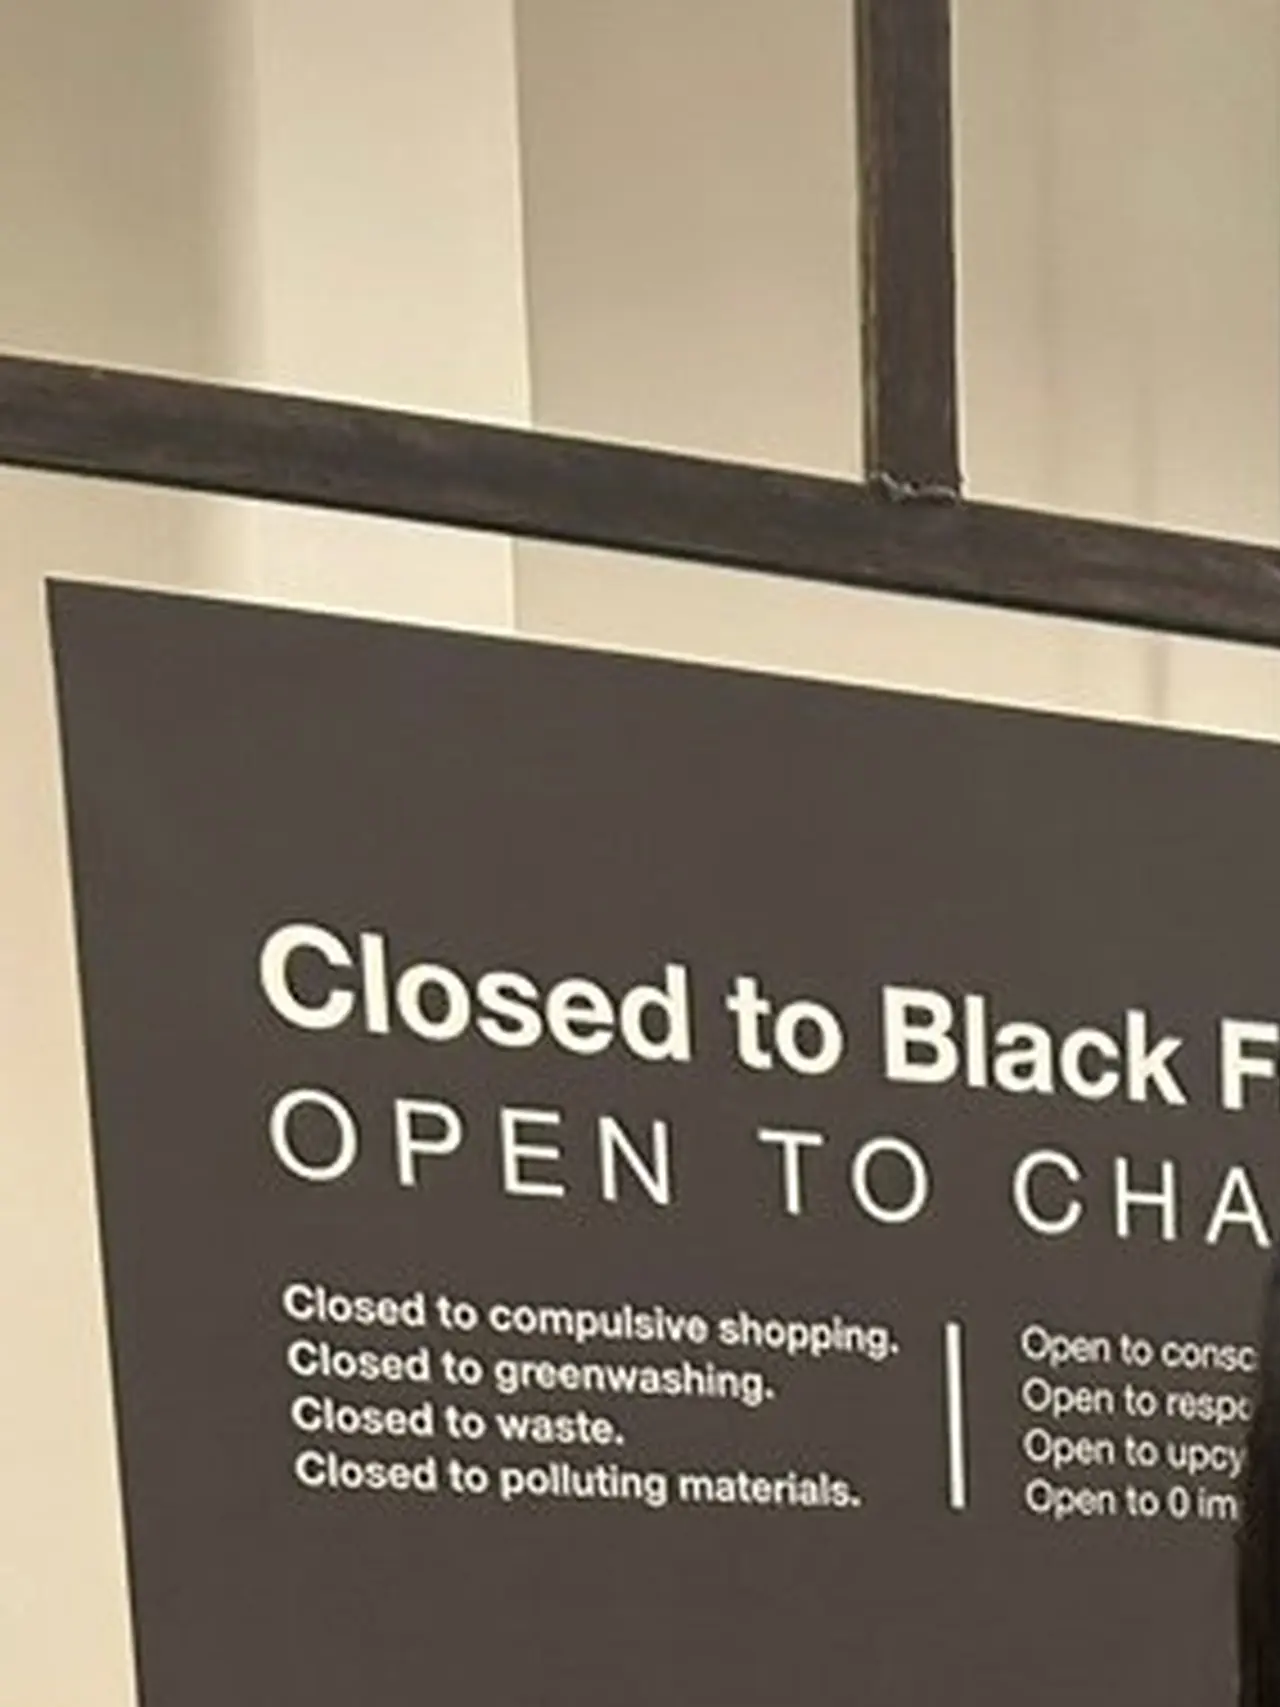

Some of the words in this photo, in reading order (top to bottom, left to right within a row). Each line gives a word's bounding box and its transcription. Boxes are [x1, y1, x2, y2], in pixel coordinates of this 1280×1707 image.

[260, 923, 691, 1062] Closed
[725, 976, 843, 1075] to
[883, 985, 1187, 1106] Black
[270, 1089, 670, 1205] OPEN
[758, 1128, 928, 1223] TO
[1013, 1149, 1271, 1248] CHA
[283, 1283, 426, 1327] Closed
[435, 1295, 478, 1331] to
[488, 1304, 709, 1344] compulsive
[718, 1311, 899, 1361] shopping.
[1021, 1325, 1111, 1367] Open
[1120, 1334, 1154, 1367] to
[287, 1339, 431, 1382] Closed
[440, 1350, 483, 1385] to
[495, 1360, 775, 1407] greenwashing.
[1022, 1376, 1114, 1418] Open
[1124, 1384, 1158, 1417] to
[291, 1395, 434, 1437] Closed
[444, 1405, 487, 1439] to
[495, 1411, 624, 1445] waste.
[1023, 1427, 1115, 1469] Open
[1125, 1435, 1159, 1467] to
[295, 1450, 438, 1491] Closed
[448, 1459, 489, 1493] to
[499, 1462, 668, 1508] polluting
[678, 1471, 861, 1507] materials.
[1025, 1478, 1116, 1519] Open
[1125, 1486, 1160, 1517] to
[1167, 1485, 1190, 1519] 0
